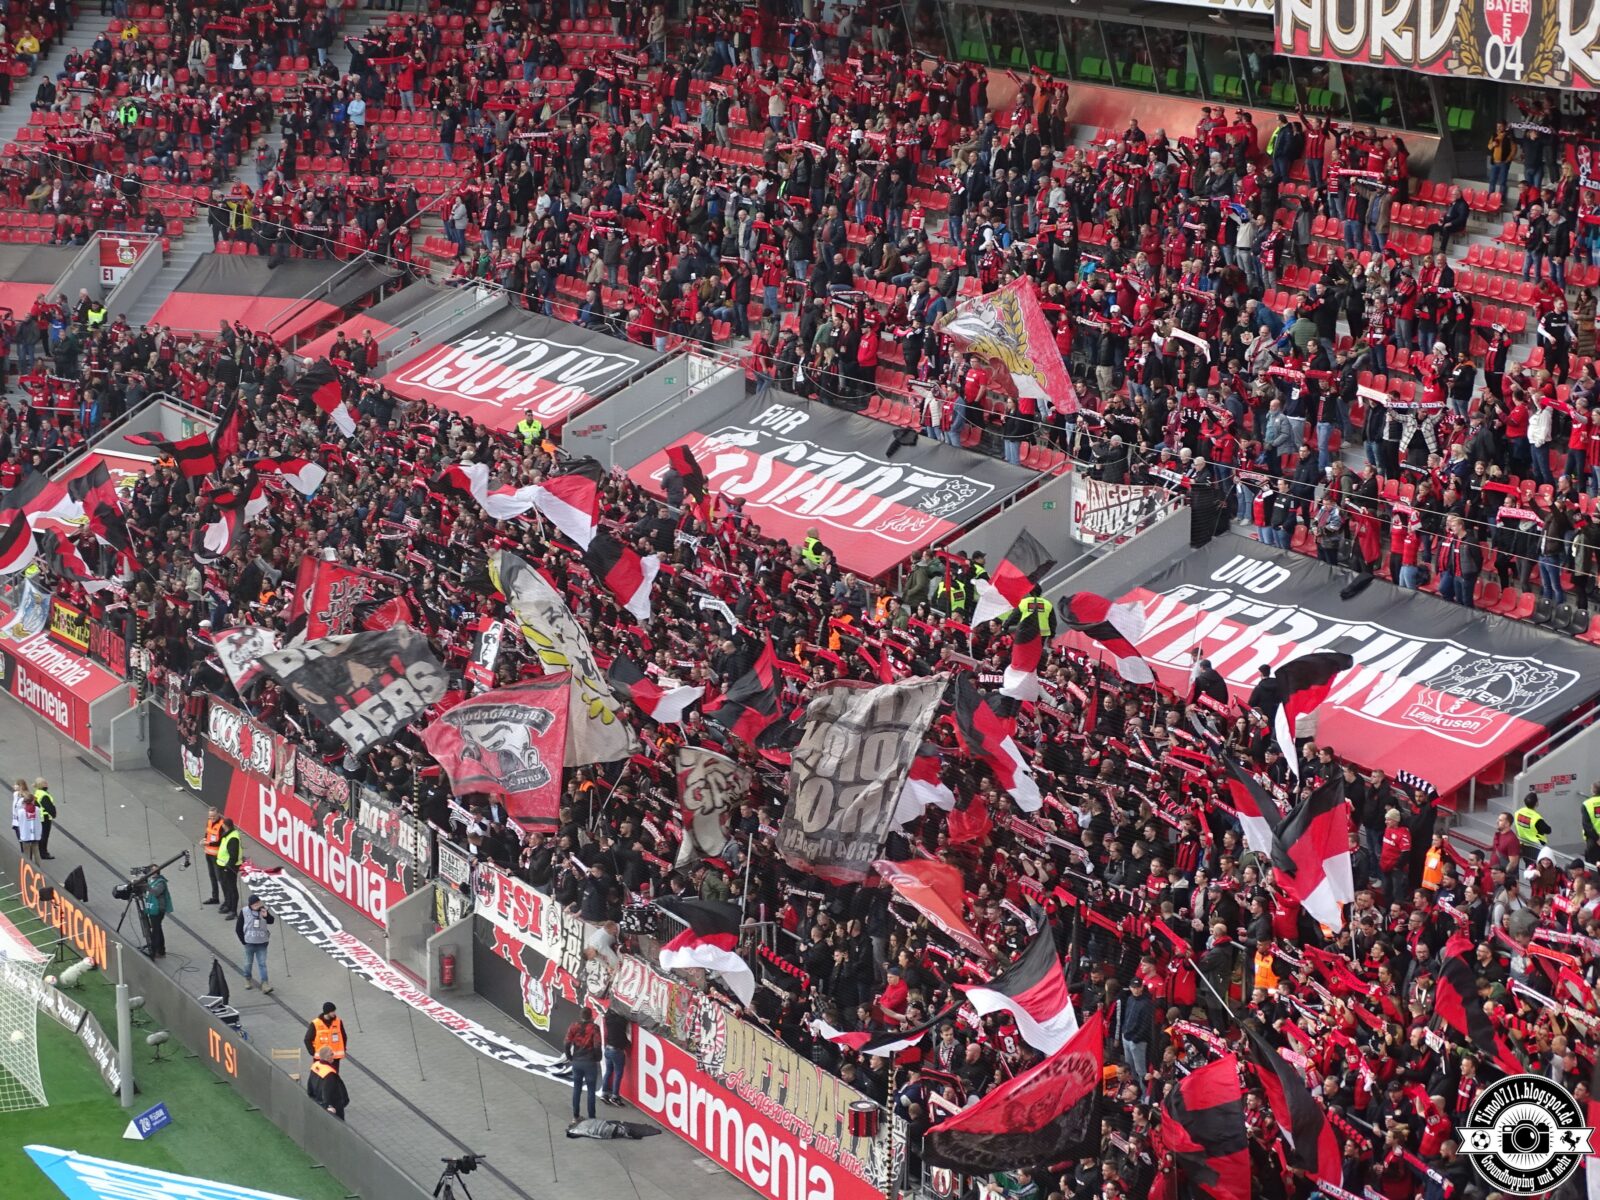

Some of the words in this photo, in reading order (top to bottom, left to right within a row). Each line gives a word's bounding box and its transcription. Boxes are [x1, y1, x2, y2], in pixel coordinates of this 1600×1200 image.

[1485, 34, 1524, 80] 04
[103, 268, 113, 280] E1
[749, 403, 811, 435] FÜR
[719, 442, 948, 528] STADT
[1210, 553, 1292, 594] UND
[17, 633, 92, 687] Barmenia
[17, 665, 69, 728] Barmenia
[329, 660, 450, 755] HERS
[1450, 687, 1503, 704] BAYER
[1409, 707, 1482, 731] Leverkusen
[259, 783, 388, 926] Barmenia
[497, 872, 543, 941] FSI
[208, 1027, 221, 1064] IT
[1003, 1036, 1016, 1054] 8
[637, 1025, 835, 1200] Barmenia
